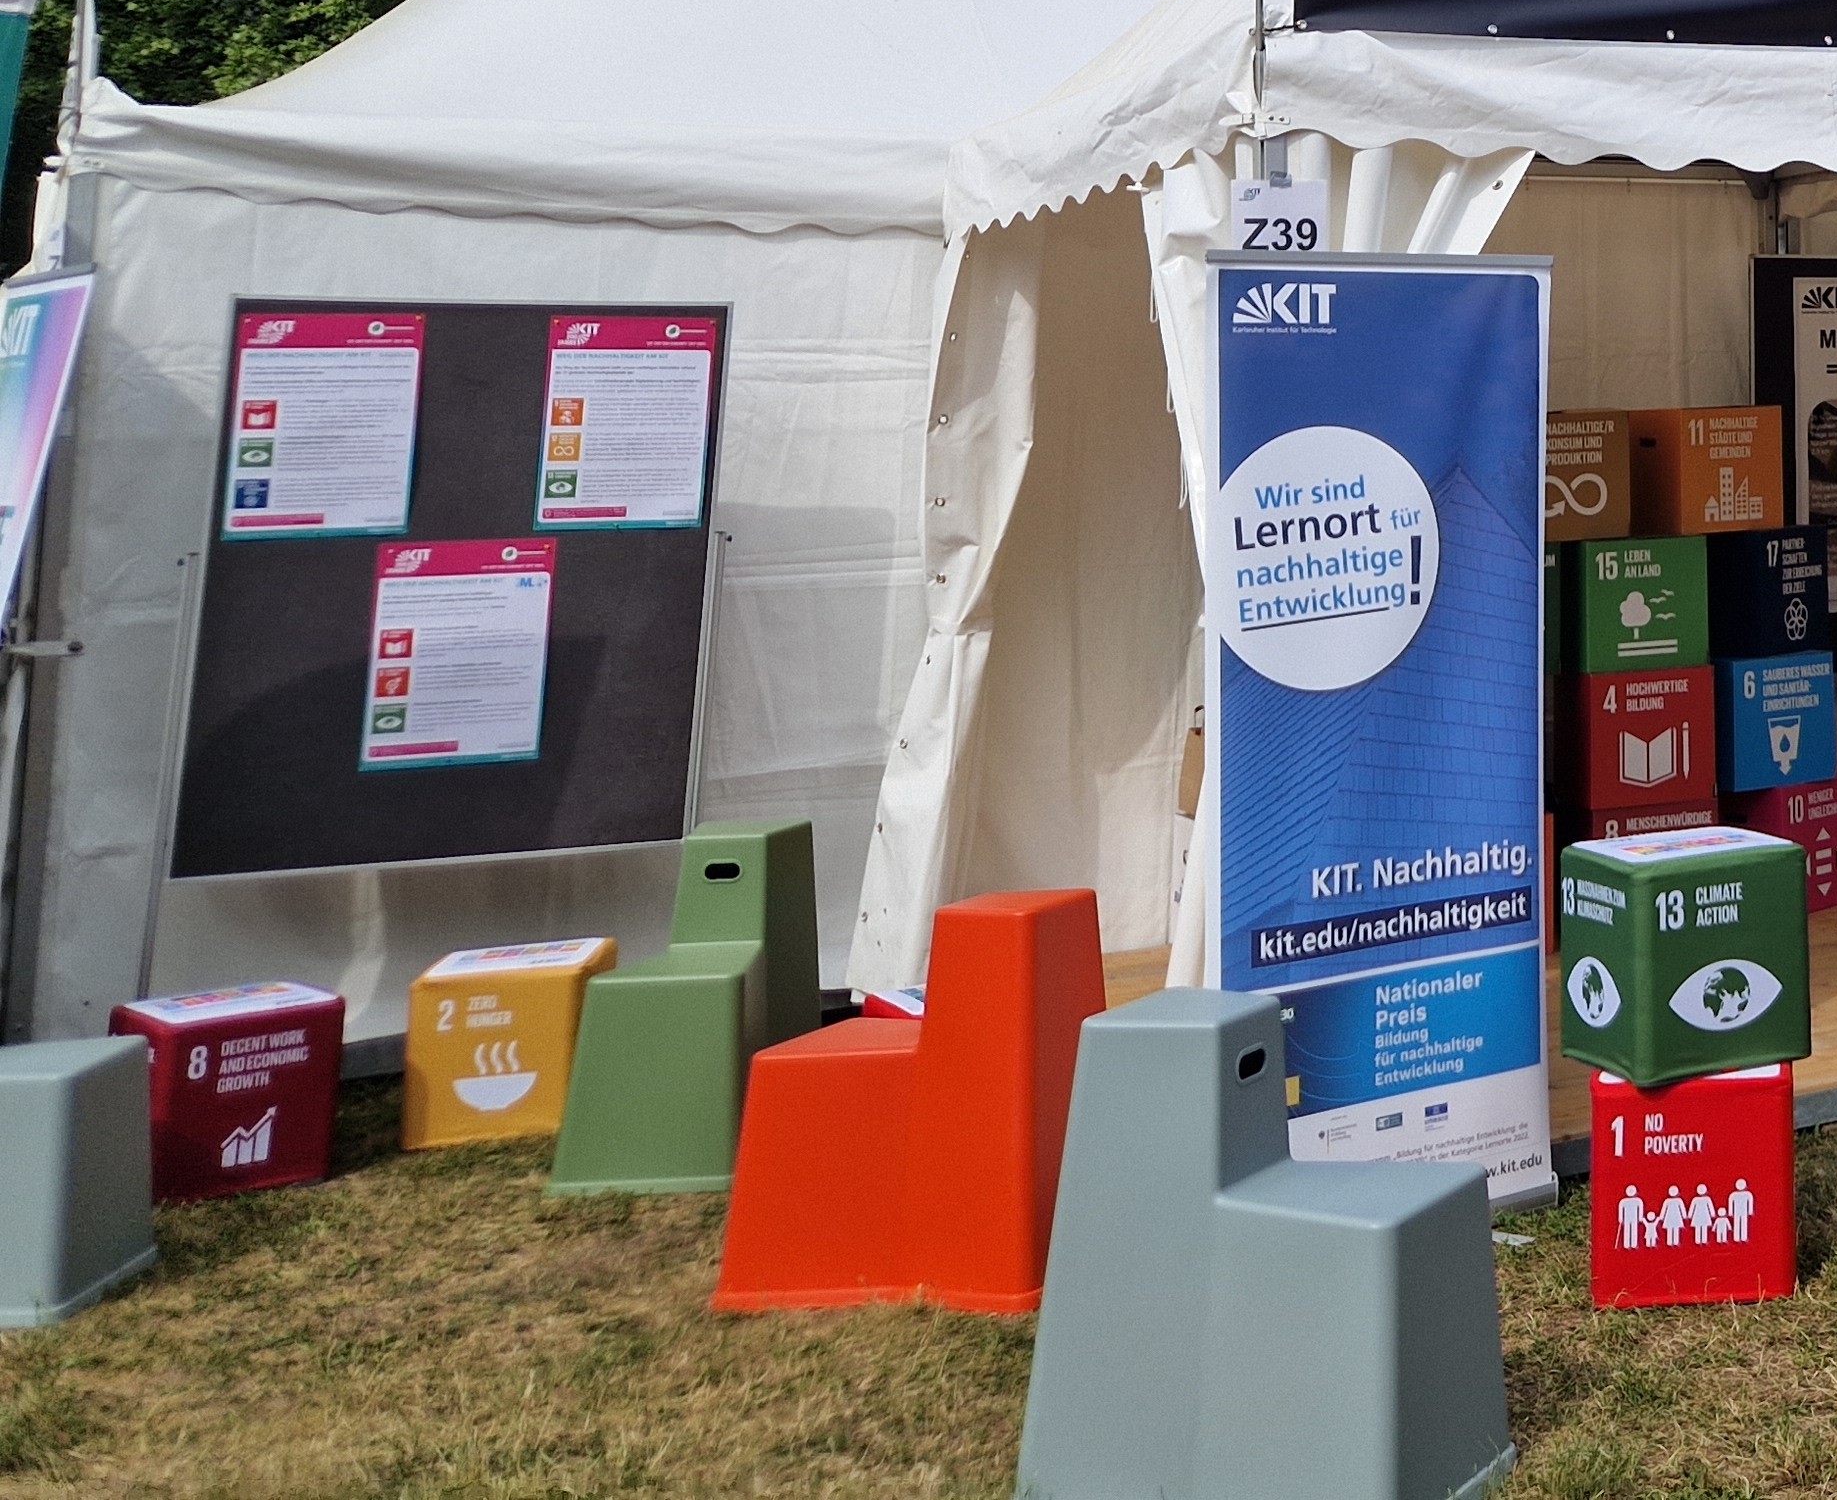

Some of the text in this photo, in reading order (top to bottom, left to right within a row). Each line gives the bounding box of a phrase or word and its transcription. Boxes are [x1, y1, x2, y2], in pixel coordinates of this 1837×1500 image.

[1242, 218, 1317, 250] Z39
[1262, 283, 1336, 324] KIT
[579, 323, 601, 335] KIT
[1301, 327, 1337, 335] Technologie
[1688, 419, 1703, 446] 11
[1709, 417, 1758, 430] NACHHALTIGE
[1584, 436, 1602, 448] UND
[1709, 431, 1753, 445] STÄDTE UND
[1546, 451, 1602, 466] PRODUKTION
[1709, 446, 1750, 460] GEMEINDEN
[1255, 475, 1365, 509] Wir sind
[1234, 503, 1421, 550] Lernort für
[1237, 546, 1403, 588] nachhaltige
[1596, 552, 1618, 580] 15
[1624, 549, 1650, 563] LEBEN
[1767, 540, 1778, 567] 17
[1624, 564, 1661, 578] AN LAND
[1239, 582, 1405, 623] Entwicklung
[1744, 671, 1755, 699] 6
[1763, 664, 1830, 681] SAUBERES WASSER
[1603, 685, 1617, 713] 4
[1626, 679, 1689, 696] HOCHWERTIGE
[1763, 680, 1811, 696] UND SANITÄR-
[1626, 696, 1664, 712] BILDUNG
[1763, 695, 1819, 712] EINRICHTUNGEN
[1787, 795, 1804, 824] 10
[1808, 788, 1833, 804] WENIGER
[1312, 839, 1533, 899] KIT. Nachhaltig.
[1562, 877, 1575, 915] 13
[1696, 882, 1743, 905] CLIMATE
[1655, 890, 1684, 931] 13
[1696, 904, 1739, 927] ACTION
[1260, 892, 1527, 961] kit.edu/nachhaltigkeit
[1375, 969, 1482, 1005] Nationaler
[437, 1000, 456, 1032] 2
[468, 995, 497, 1011] ZERO
[1375, 1004, 1427, 1031] Preis
[221, 1029, 306, 1057] DECENT WORK
[1375, 1027, 1428, 1049] Bildung
[1375, 1035, 1483, 1068] für nachhaltige
[188, 1045, 207, 1080] 8
[219, 1046, 310, 1075] AND ECONOMIC
[1375, 1057, 1464, 1086] Entwicklung
[216, 1071, 270, 1094] GROWTH
[1645, 1113, 1663, 1132] NO
[1424, 1136, 1474, 1152] für nachhaltige
[1611, 1116, 1623, 1157] 1
[1645, 1133, 1703, 1155] POVERTY
[1438, 1150, 1448, 1160] der
[1451, 1145, 1484, 1157] Kategorie
